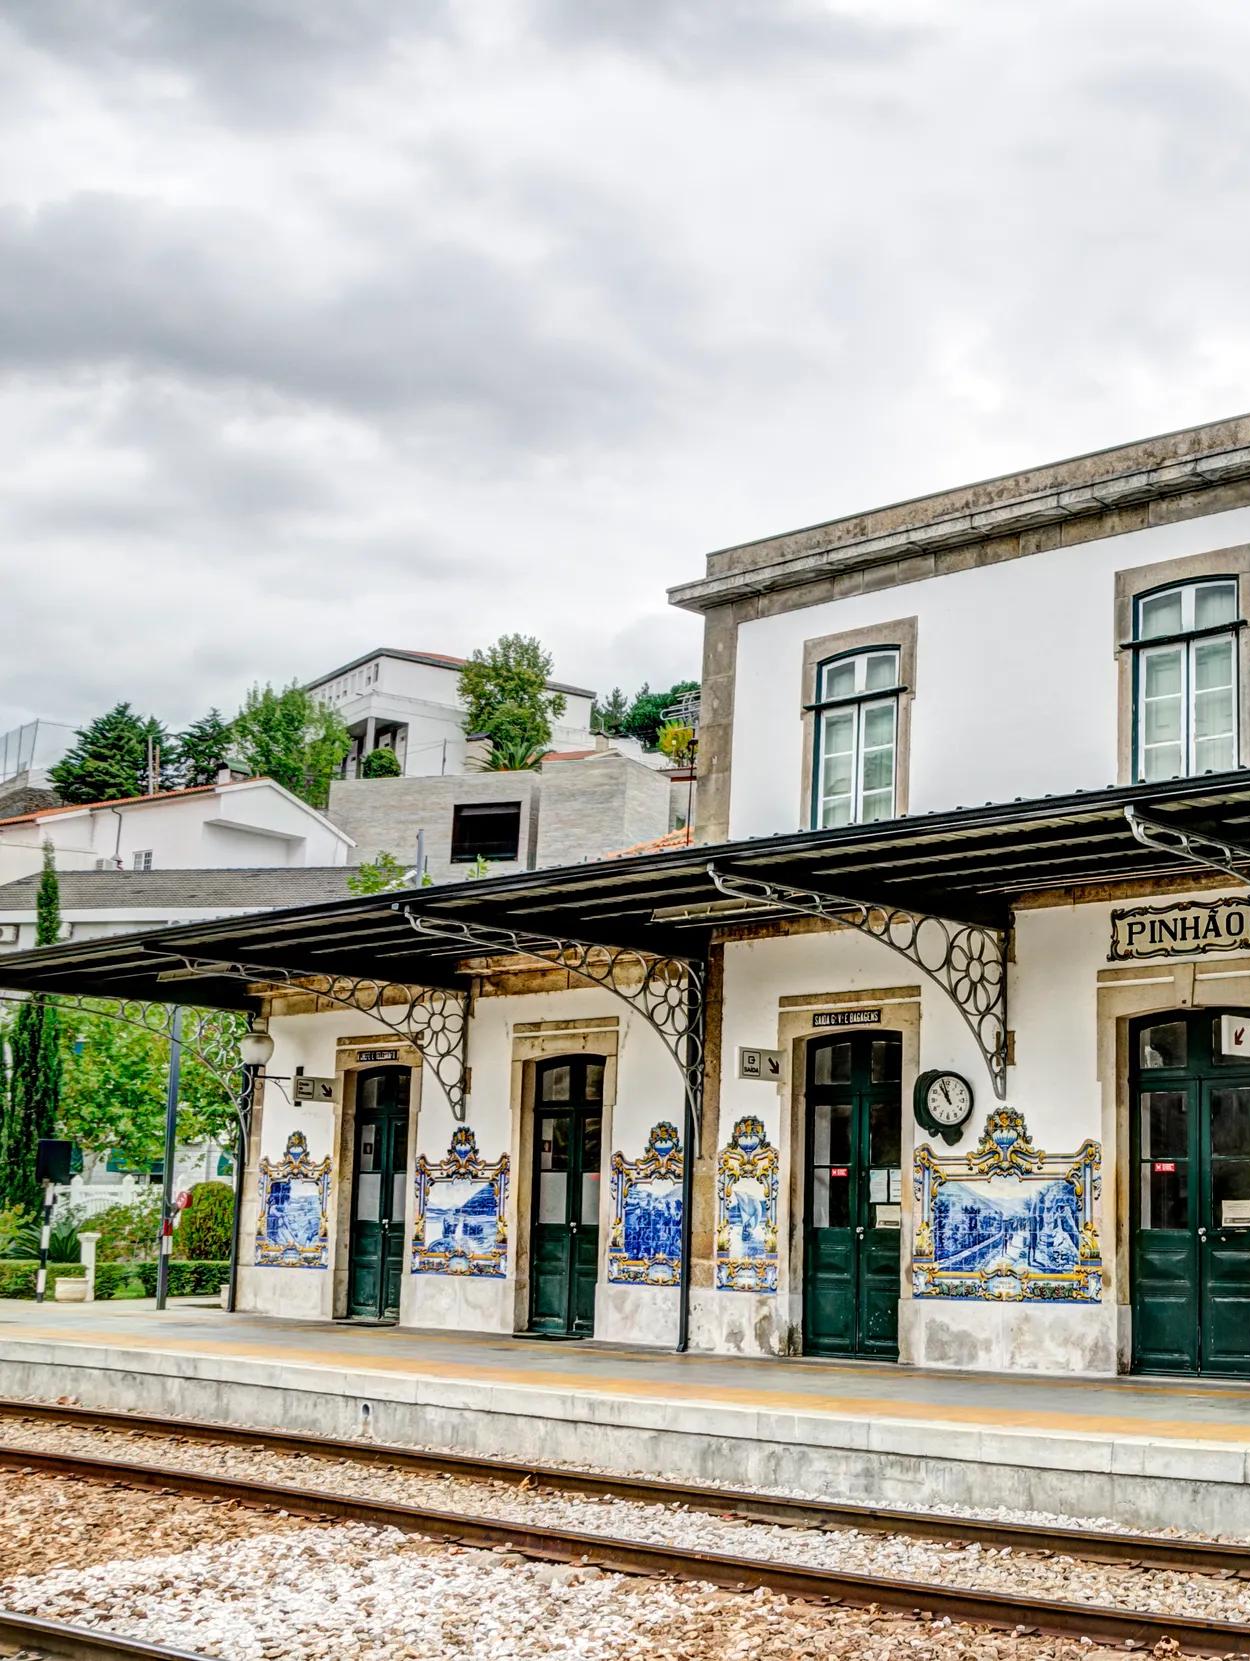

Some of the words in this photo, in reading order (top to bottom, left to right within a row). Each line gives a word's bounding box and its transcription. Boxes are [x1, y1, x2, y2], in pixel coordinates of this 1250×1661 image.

[1127, 909, 1244, 946] PINHÃO
[814, 1015, 830, 1025] SAIDA
[844, 1013, 848, 1023] E
[850, 1011, 879, 1023] BAGAGENS
